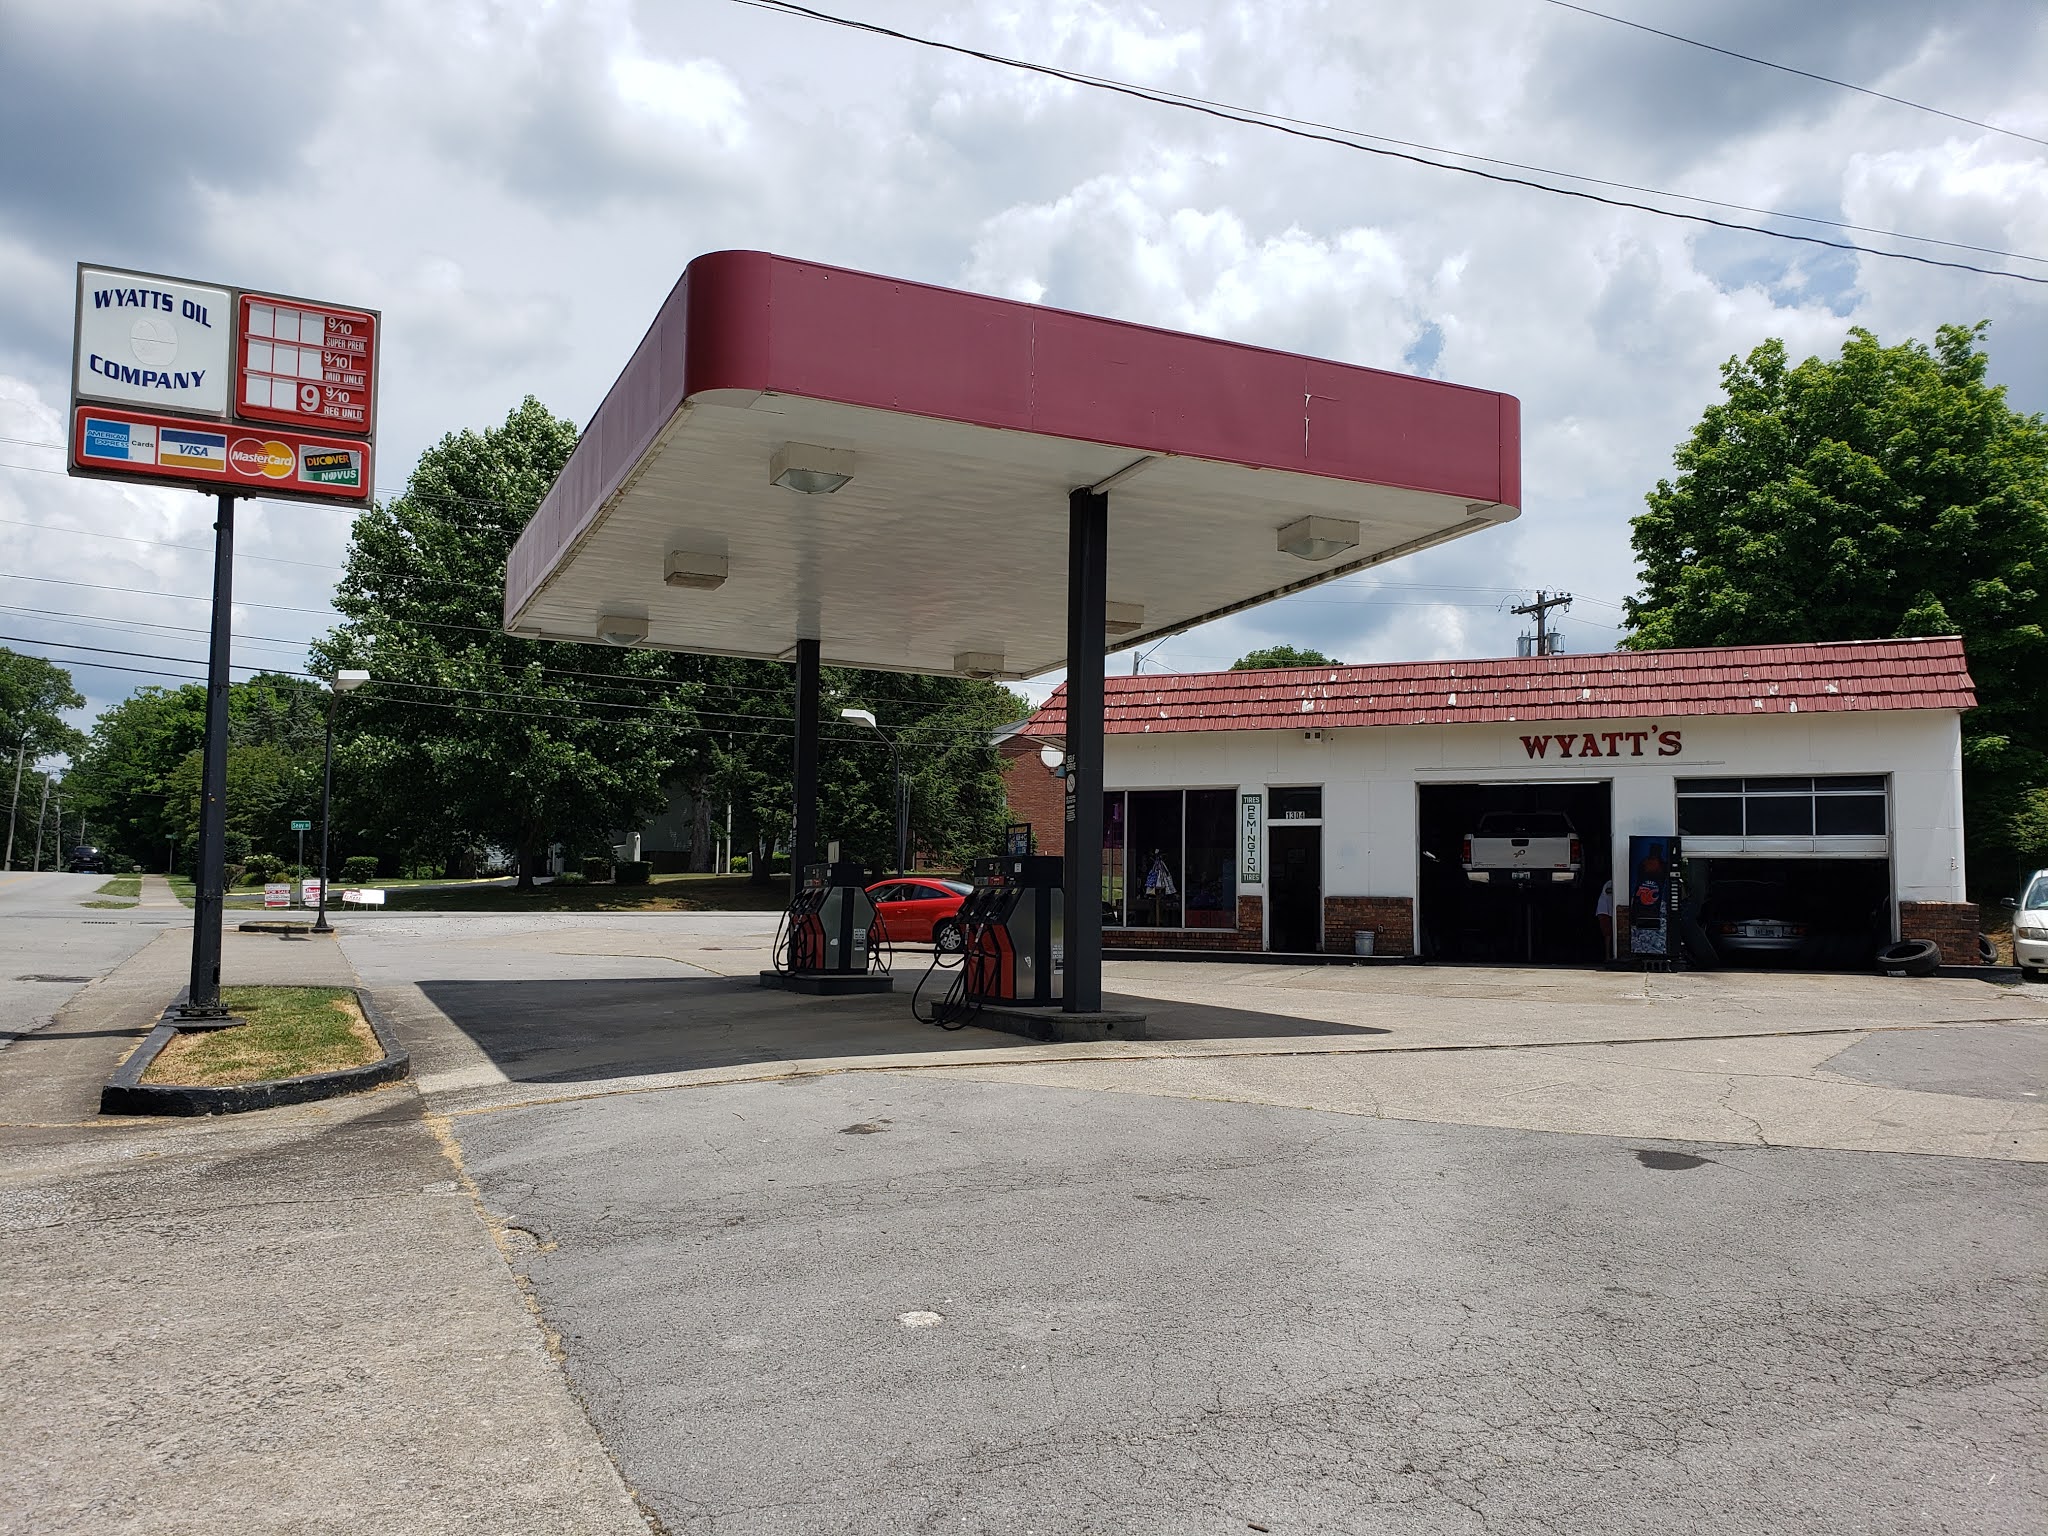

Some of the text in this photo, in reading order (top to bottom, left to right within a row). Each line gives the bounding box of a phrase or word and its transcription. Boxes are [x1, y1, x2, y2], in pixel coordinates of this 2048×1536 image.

[94, 289, 212, 328] WYATTS OIL
[327, 317, 352, 335] 9/10
[326, 337, 364, 352] SUPER PREM
[324, 351, 348, 369] 9/10
[90, 354, 206, 390] COMPANY
[325, 371, 364, 385] MID UNLD
[300, 384, 350, 412] 9 9/10
[324, 405, 363, 419] REG UNLD
[87, 429, 128, 442] AMERICAN
[95, 438, 154, 448] EXPRESS Cards
[179, 444, 209, 457] VISA
[232, 450, 293, 467] MasterCard
[306, 454, 350, 467] DISCOVER
[321, 470, 357, 481] NOVUS
[1519, 725, 1682, 759] WYATT'S
[1286, 811, 1305, 819] 1304
[1246, 805, 1257, 872] REMINGTON
